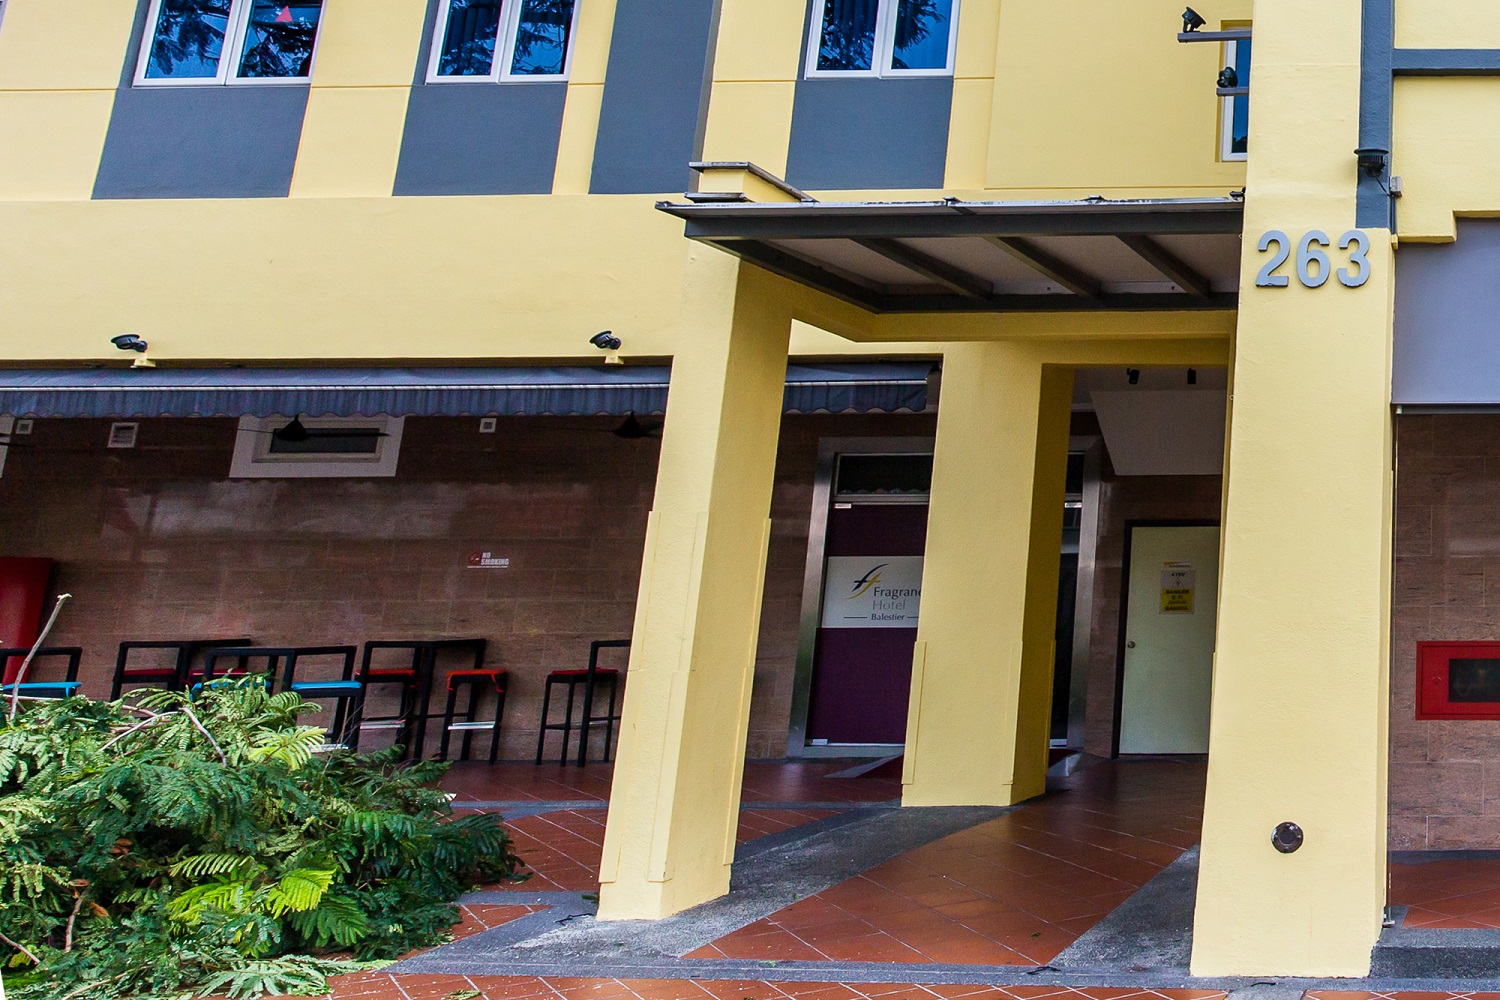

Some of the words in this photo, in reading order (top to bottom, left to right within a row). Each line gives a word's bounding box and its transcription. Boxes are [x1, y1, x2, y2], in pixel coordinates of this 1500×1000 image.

[1255, 230, 1371, 288] 263
[481, 558, 510, 566] SMOKING
[872, 599, 906, 611] Hotel
[871, 613, 905, 621] Balestier
